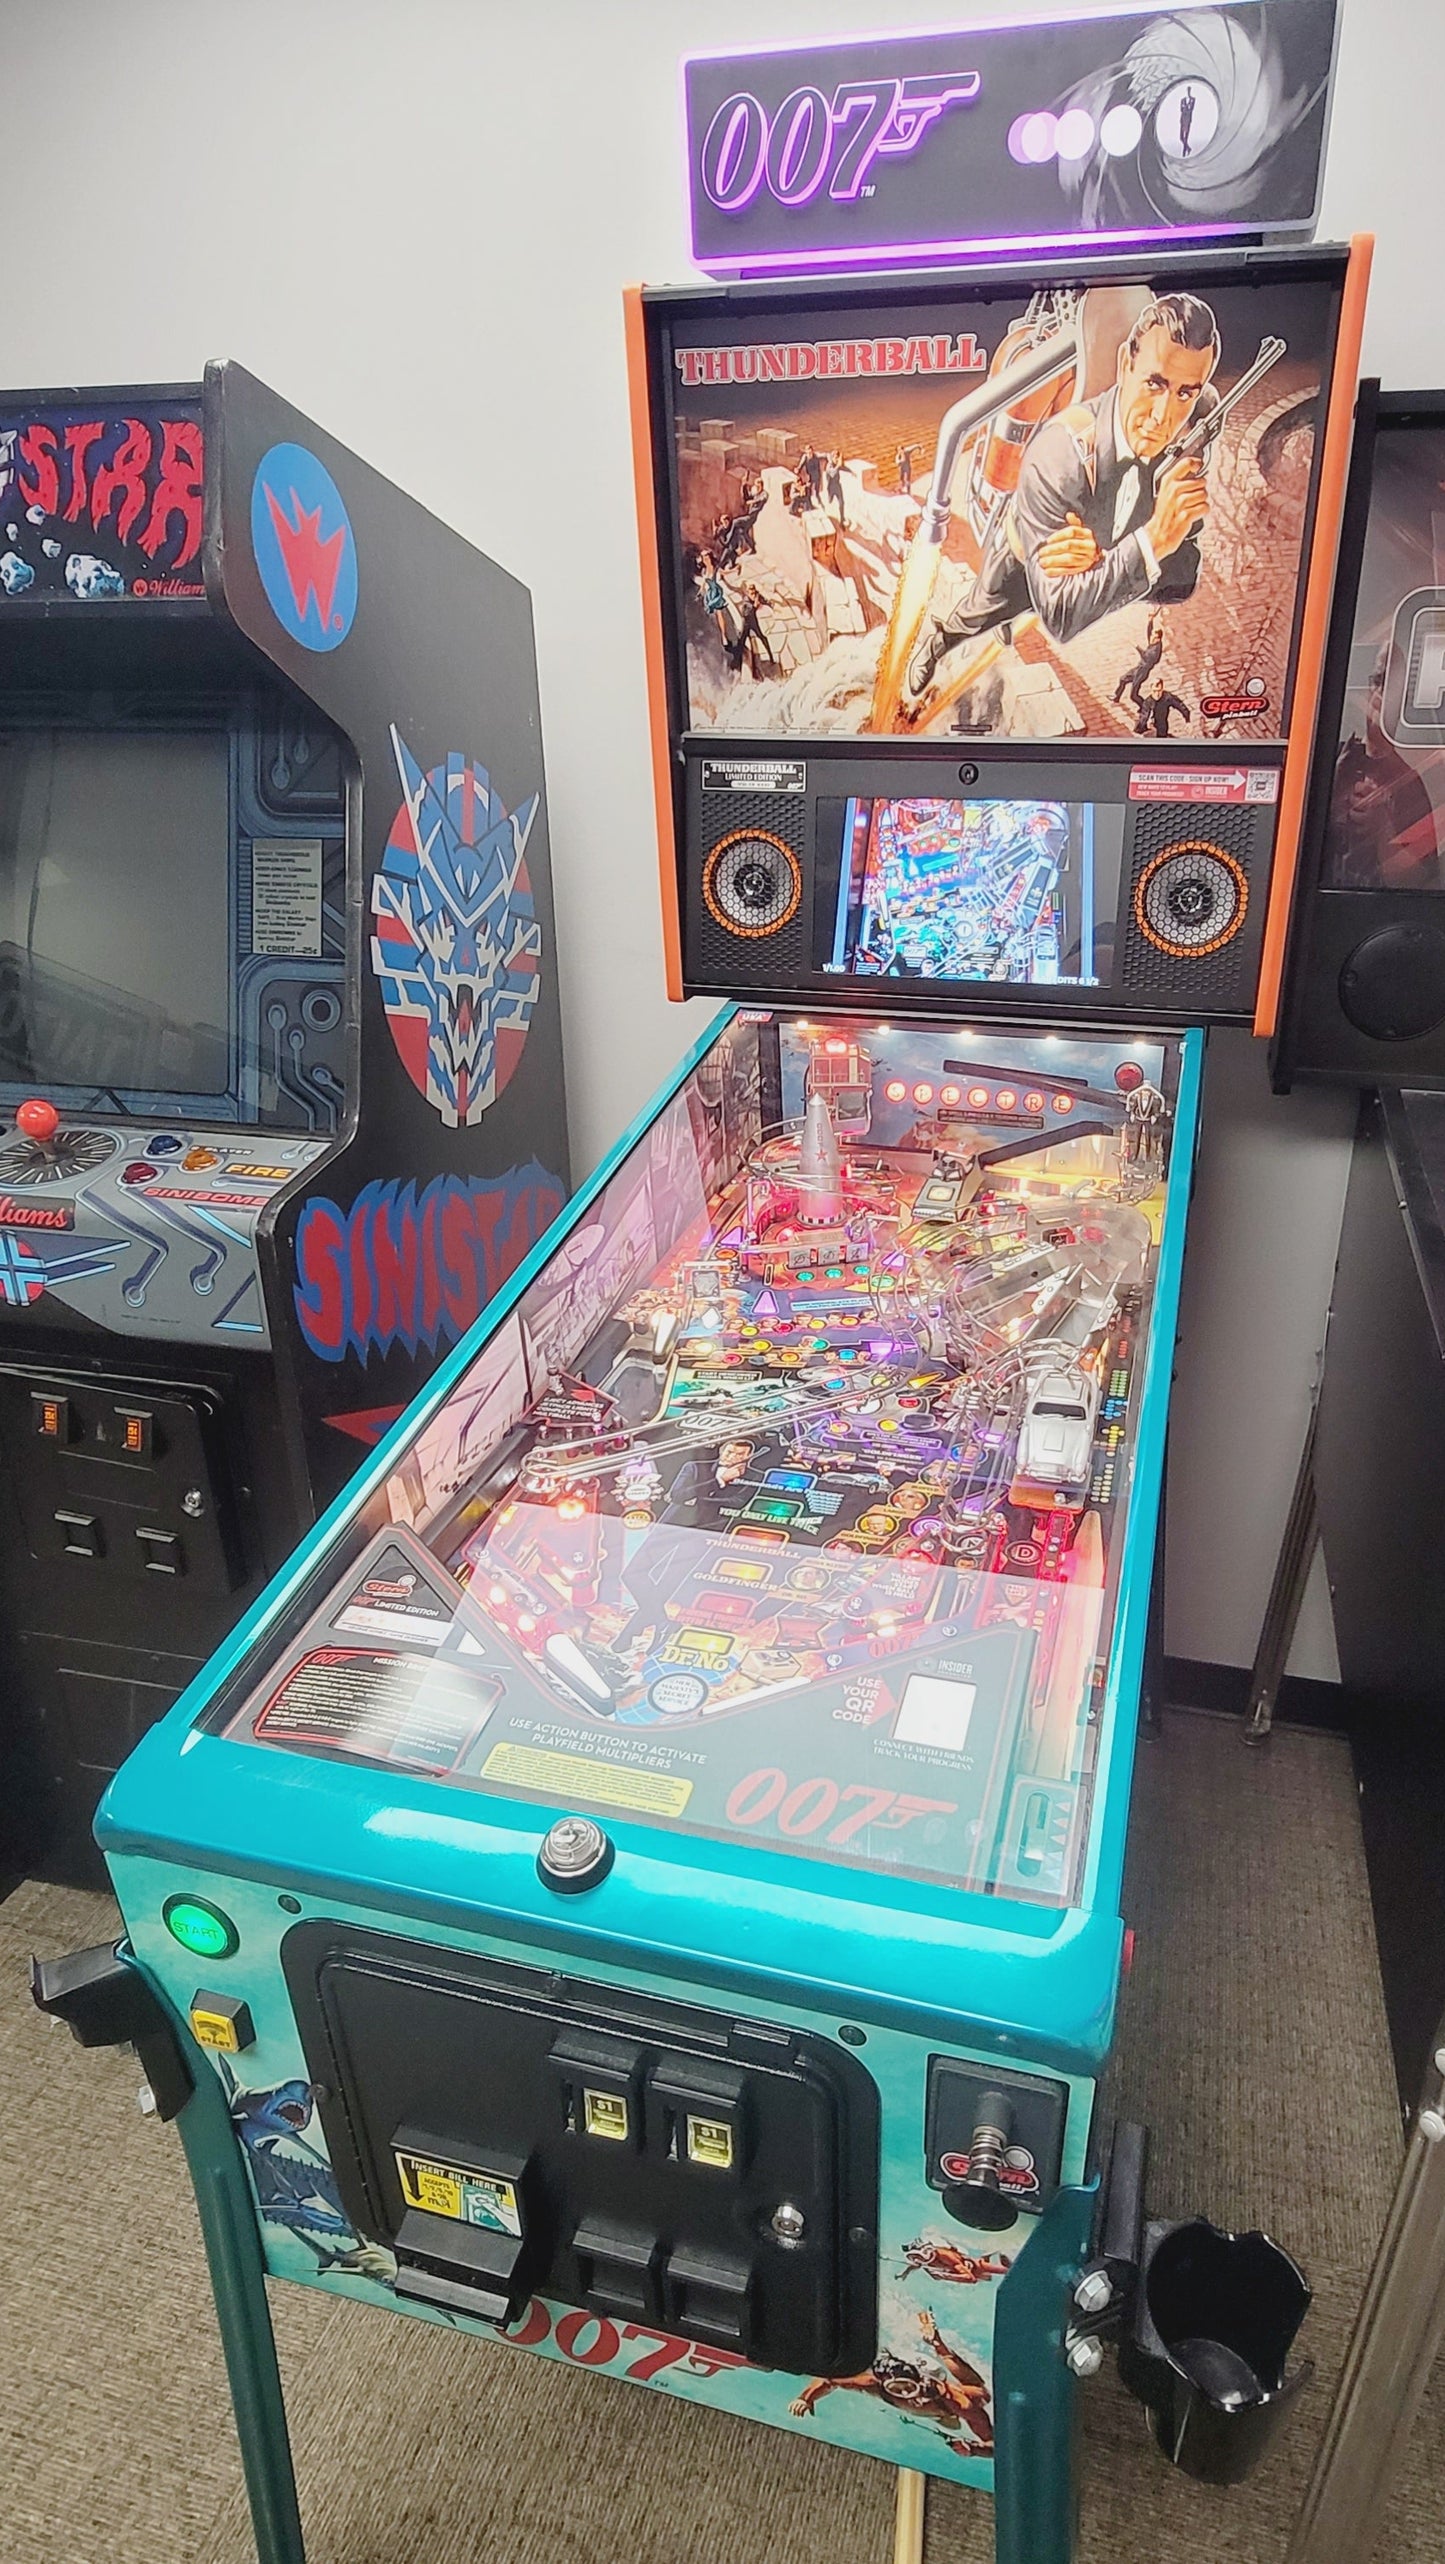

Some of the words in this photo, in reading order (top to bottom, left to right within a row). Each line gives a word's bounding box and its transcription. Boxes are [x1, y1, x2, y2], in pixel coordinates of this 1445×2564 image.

[702, 76, 902, 210] 007
[675, 334, 987, 386] THUNDERBALL
[149, 579, 206, 595] William
[710, 763, 797, 774] THUNDERBALL
[725, 772, 753, 781] LIMITED
[754, 773, 783, 782] EDITION
[1138, 774, 1154, 782] SCAN
[1189, 775, 1203, 783] SIGN
[225, 1163, 293, 1179] FIRE
[719, 1507, 742, 1518] YOU
[741, 1510, 767, 1521] ONLY
[766, 1514, 790, 1525] LIVE
[705, 1538, 802, 1559] THUNDERBALL
[692, 1571, 779, 1592] GOLDFINGER
[374, 1600, 407, 1611] LIMITED
[406, 1606, 440, 1617] EDITION
[373, 1656, 407, 1668] MISSION
[938, 1659, 973, 1675] INSIDER
[857, 1676, 883, 1690] USE
[842, 1684, 880, 1700] YOUR
[845, 1697, 876, 1713] QR
[832, 1709, 873, 1725] CODE
[509, 1717, 530, 1730] USE
[531, 1722, 579, 1739] ACTION
[579, 1730, 630, 1749] BUTTON
[631, 1740, 649, 1753] TO
[648, 1744, 708, 1765] ACTIVATE
[873, 1738, 913, 1751] CONNECT
[531, 1732, 593, 1753] PLAYFIELD
[593, 1745, 672, 1769] MULTIPLIERS
[873, 1746, 901, 1758] TRACK
[902, 1750, 927, 1763] YOUR
[725, 1766, 899, 1845] 007
[173, 1921, 218, 1940] START
[200, 2035, 231, 2048] START
[410, 2159, 445, 2178] INSERT
[447, 2172, 469, 2184] BILL
[471, 2178, 498, 2192] HERE
[493, 2299, 693, 2383] 007
